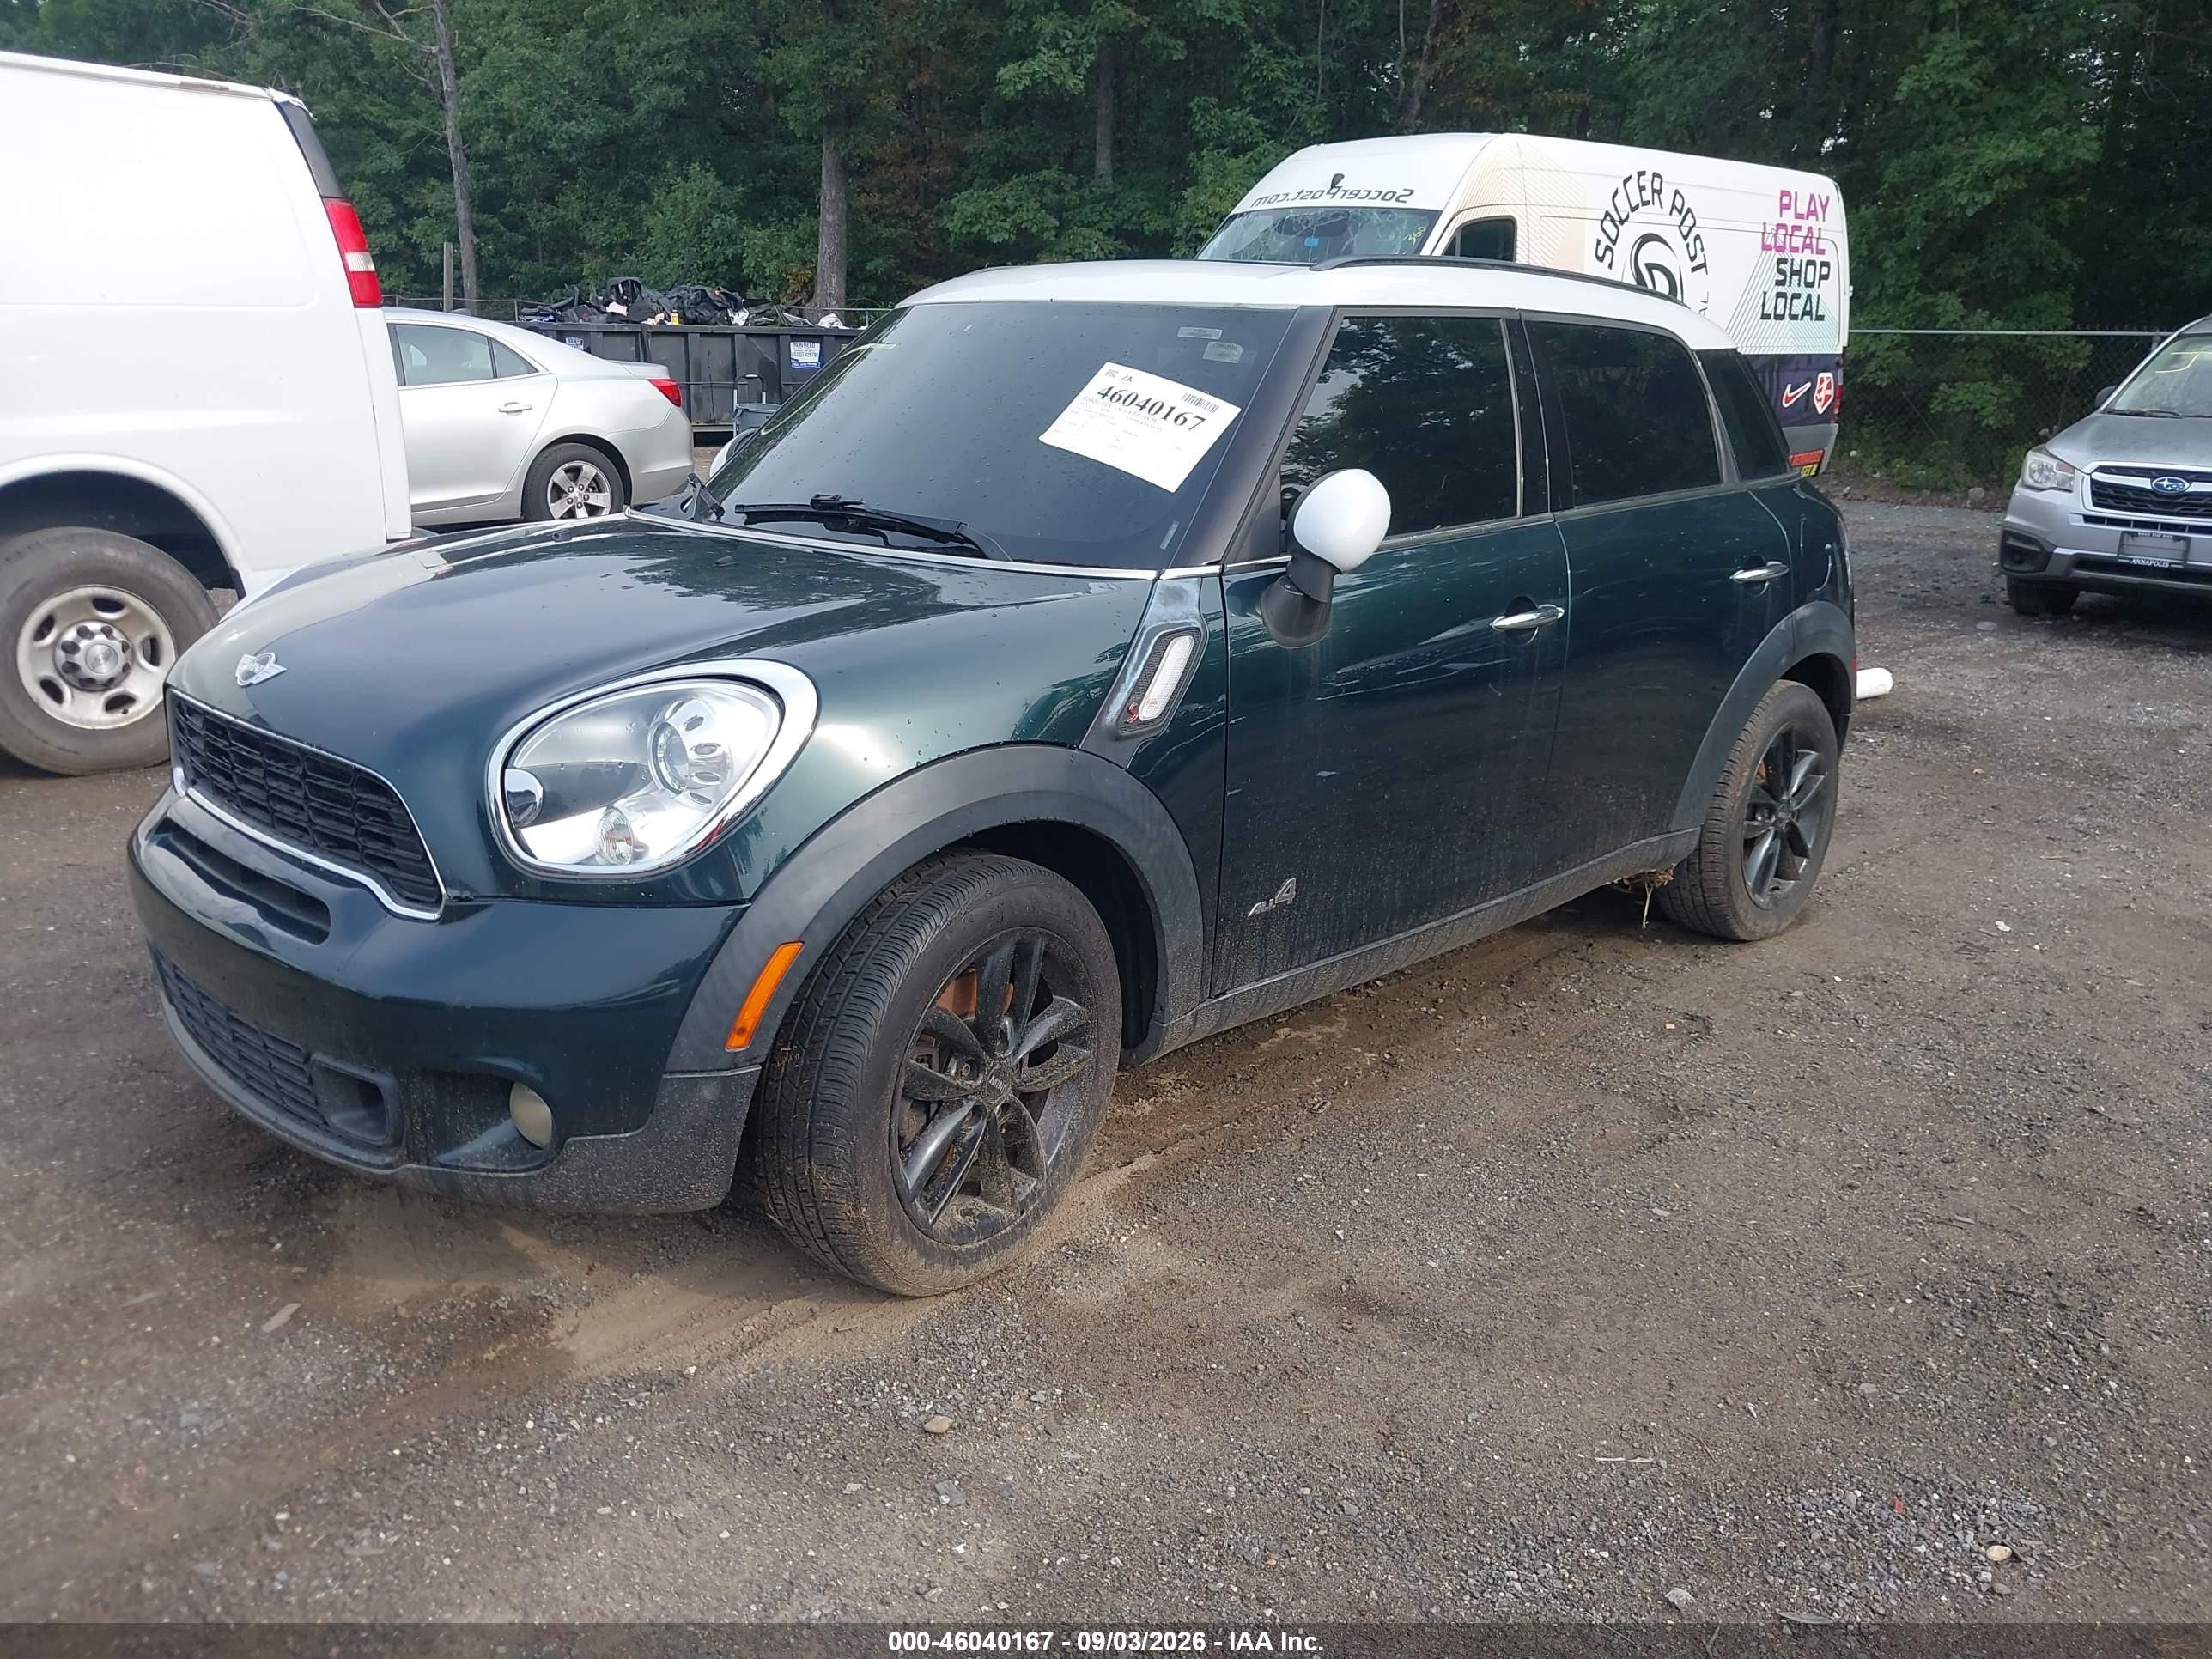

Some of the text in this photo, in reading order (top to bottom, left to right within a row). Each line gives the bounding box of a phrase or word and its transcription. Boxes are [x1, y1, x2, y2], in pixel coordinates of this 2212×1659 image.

[1779, 190, 1830, 222] PLAY
[1595, 170, 1708, 275] SOCCER POST
[1761, 222, 1826, 255] LOCAL
[1775, 258, 1831, 288] SHOP
[1760, 291, 1826, 321] LOCAL
[1097, 386, 1206, 431] 46040167
[2130, 558, 2170, 568] ANNAPOLIS
